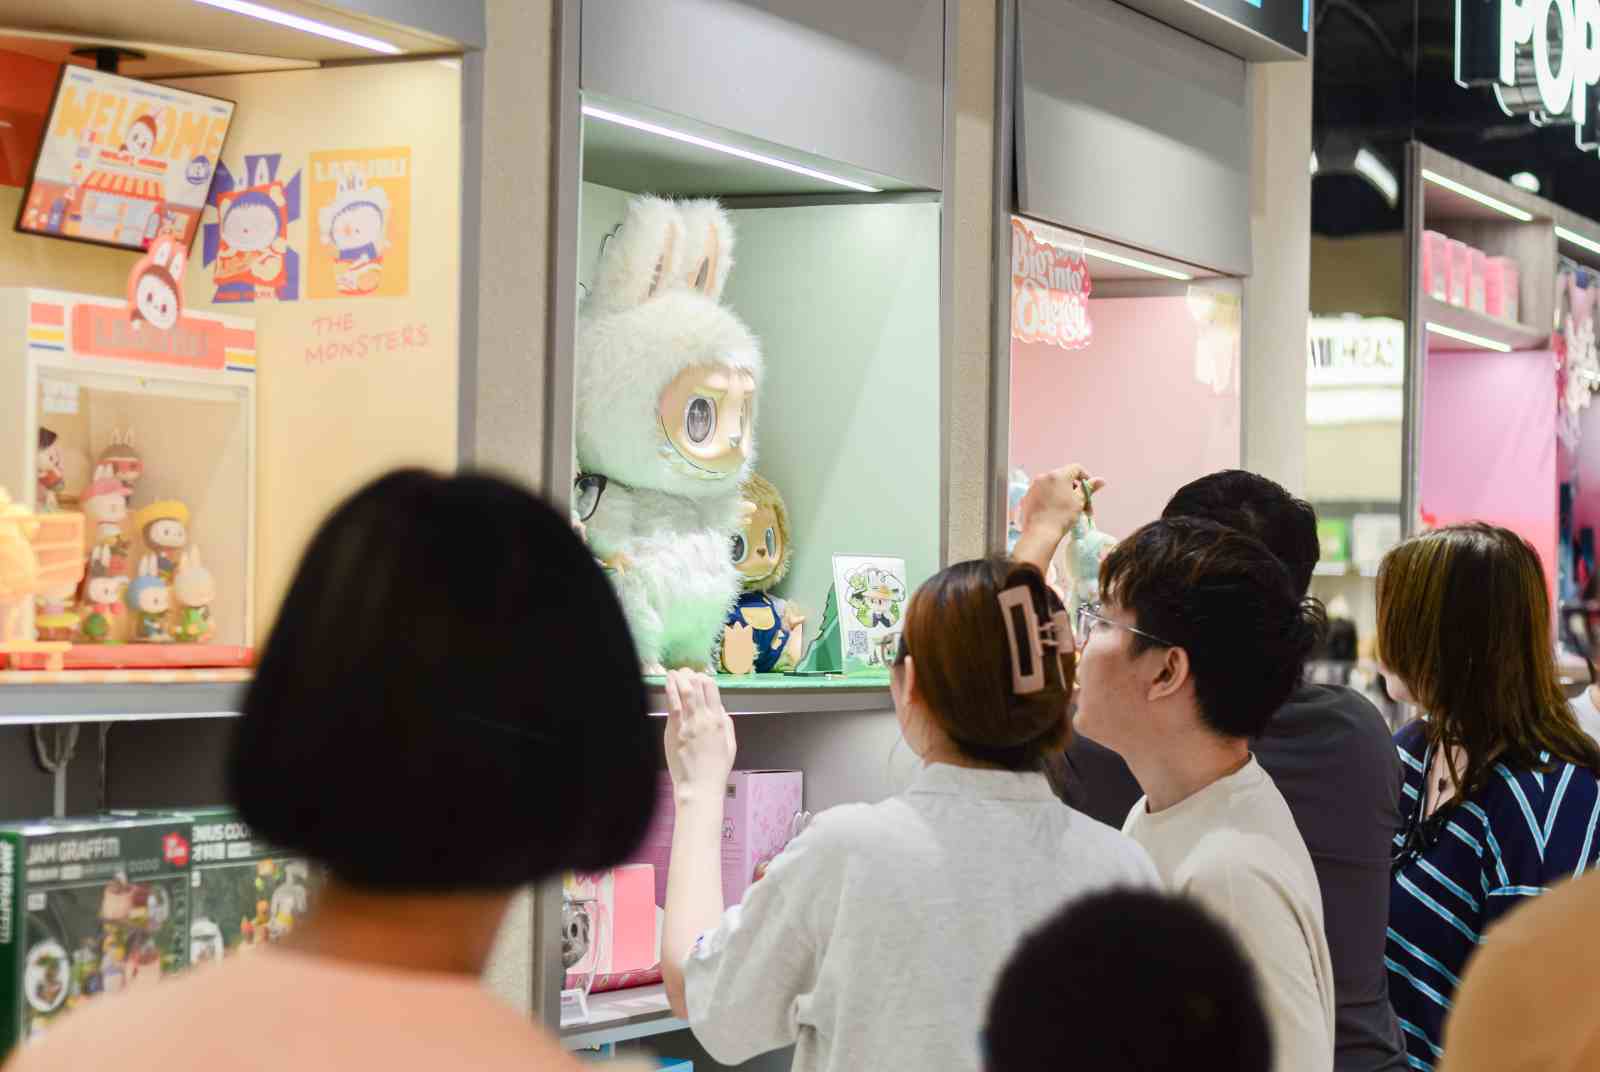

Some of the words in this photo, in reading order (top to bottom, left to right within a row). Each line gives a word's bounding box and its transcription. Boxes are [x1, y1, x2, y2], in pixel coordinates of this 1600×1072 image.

[312, 313, 354, 336] THE
[304, 323, 431, 365] MONSTERS
[26, 841, 57, 866] JAM
[59, 836, 120, 862] GRAFFITI
